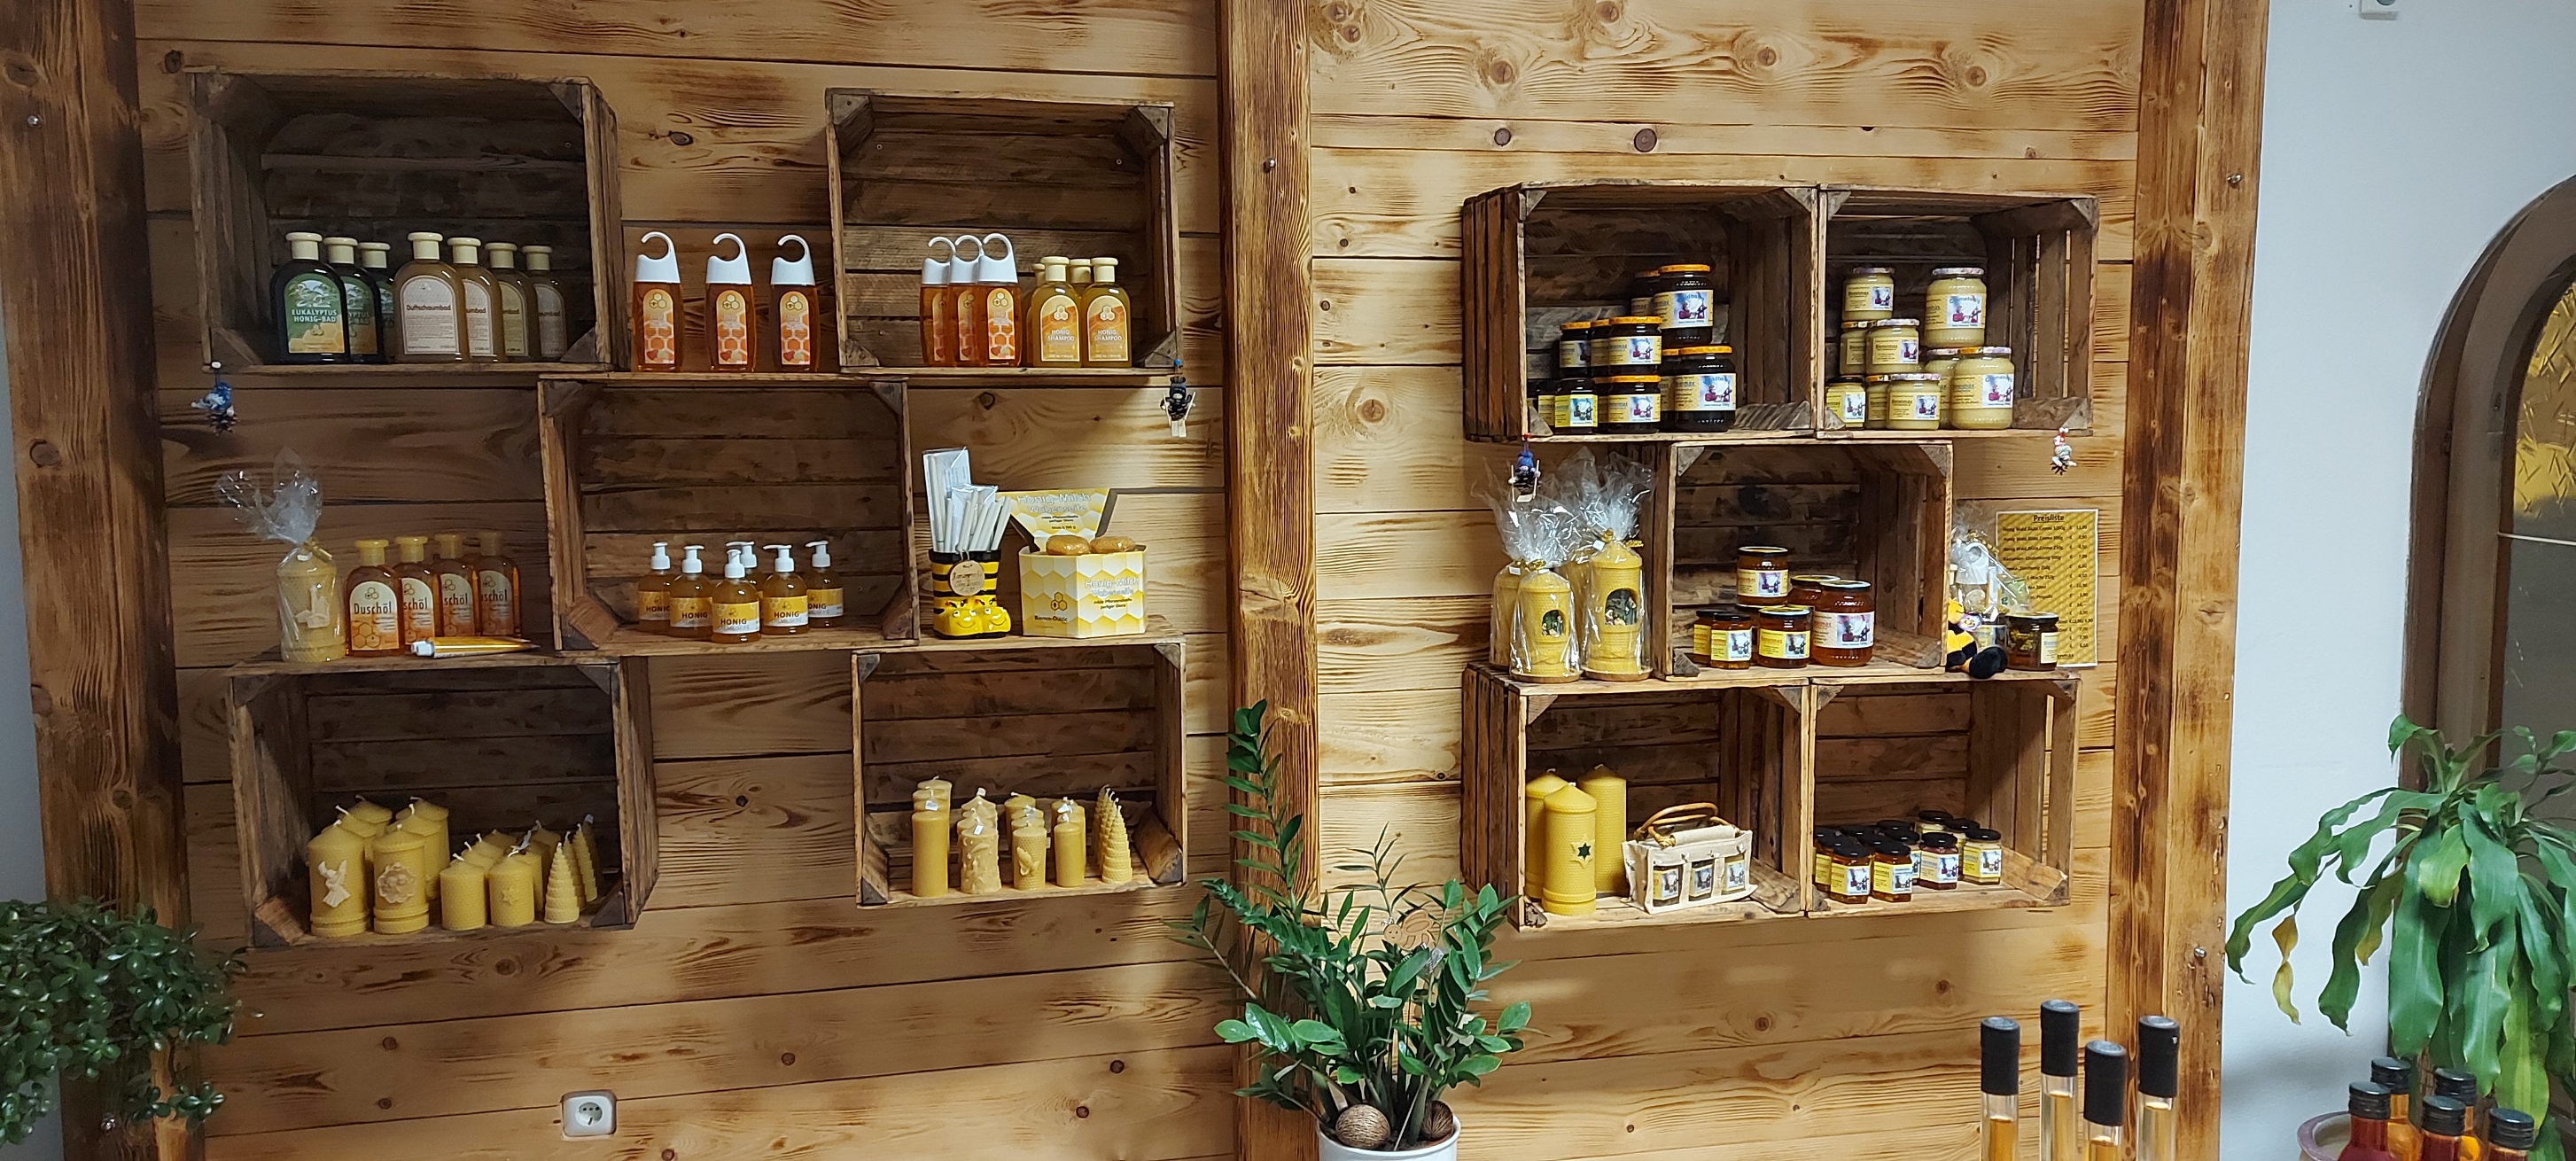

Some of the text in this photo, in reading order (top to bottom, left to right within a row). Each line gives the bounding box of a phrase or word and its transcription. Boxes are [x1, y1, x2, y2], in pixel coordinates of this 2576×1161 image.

[2033, 514, 2065, 523] Preisliste
[403, 596, 427, 610] schöl
[444, 592, 468, 605] schöl
[354, 600, 392, 614] Duschöl
